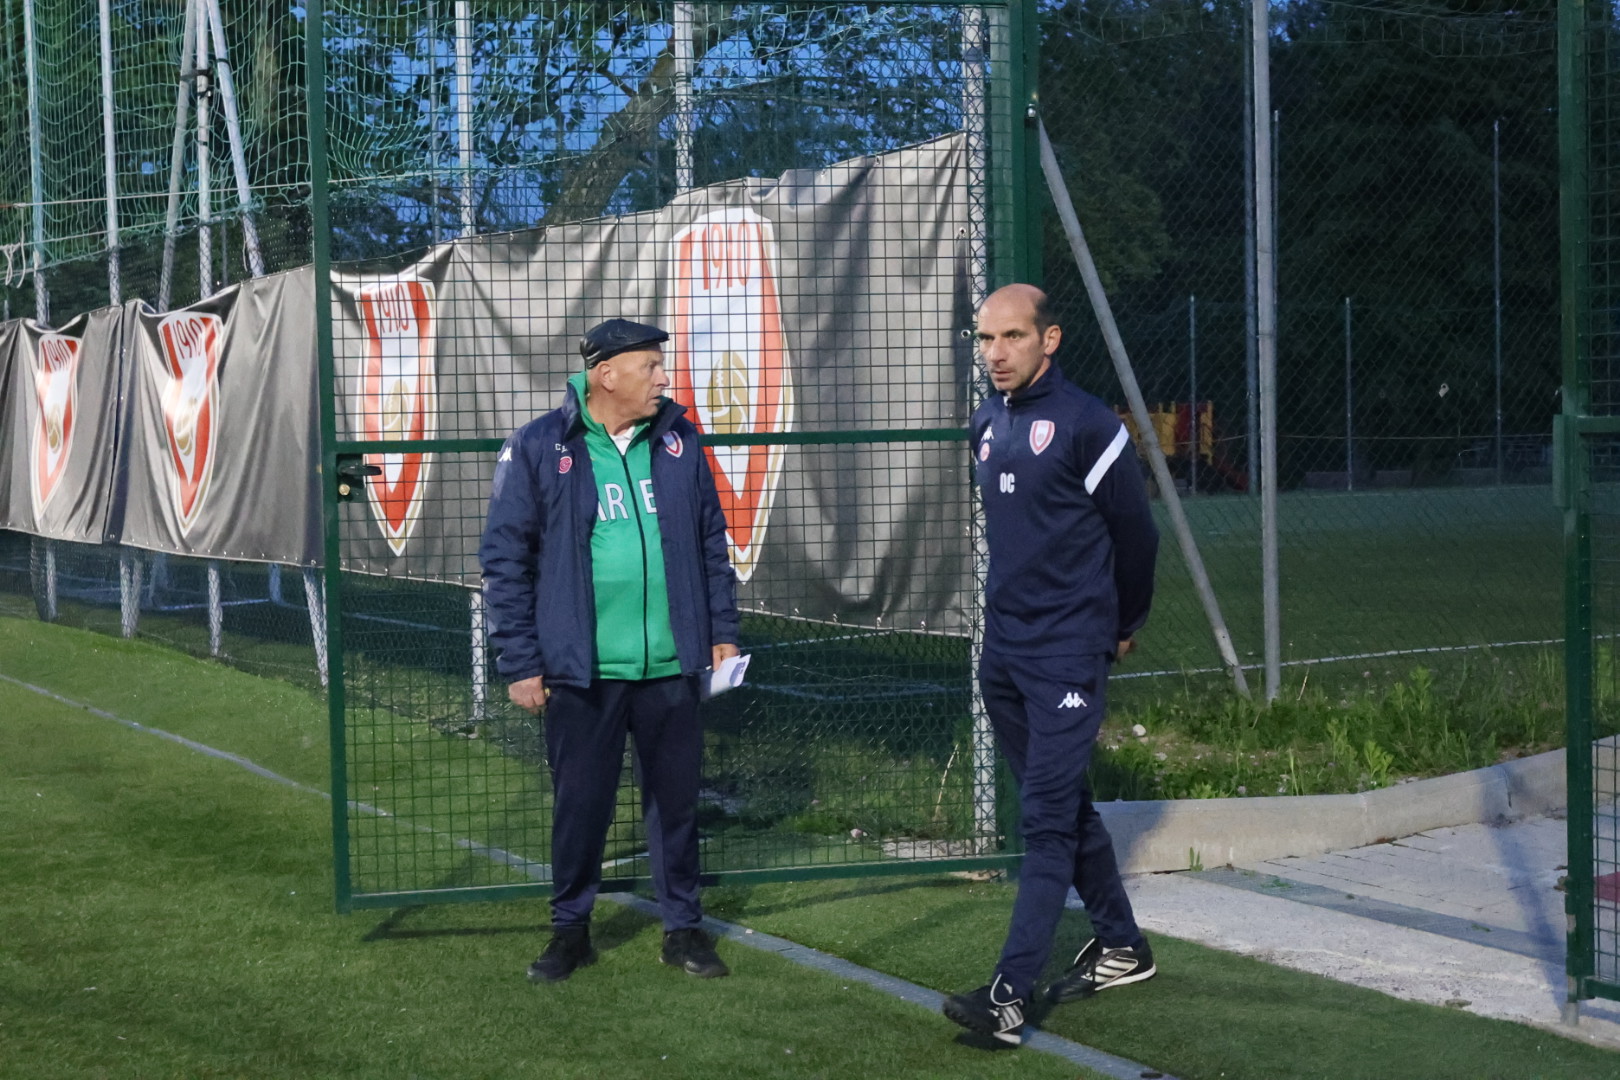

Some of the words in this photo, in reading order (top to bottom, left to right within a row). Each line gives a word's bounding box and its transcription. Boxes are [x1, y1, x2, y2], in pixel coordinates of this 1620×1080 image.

[701, 218, 751, 290] 1910
[374, 283, 409, 334] 1910
[173, 318, 203, 359] 1910
[999, 472, 1016, 494] OC
